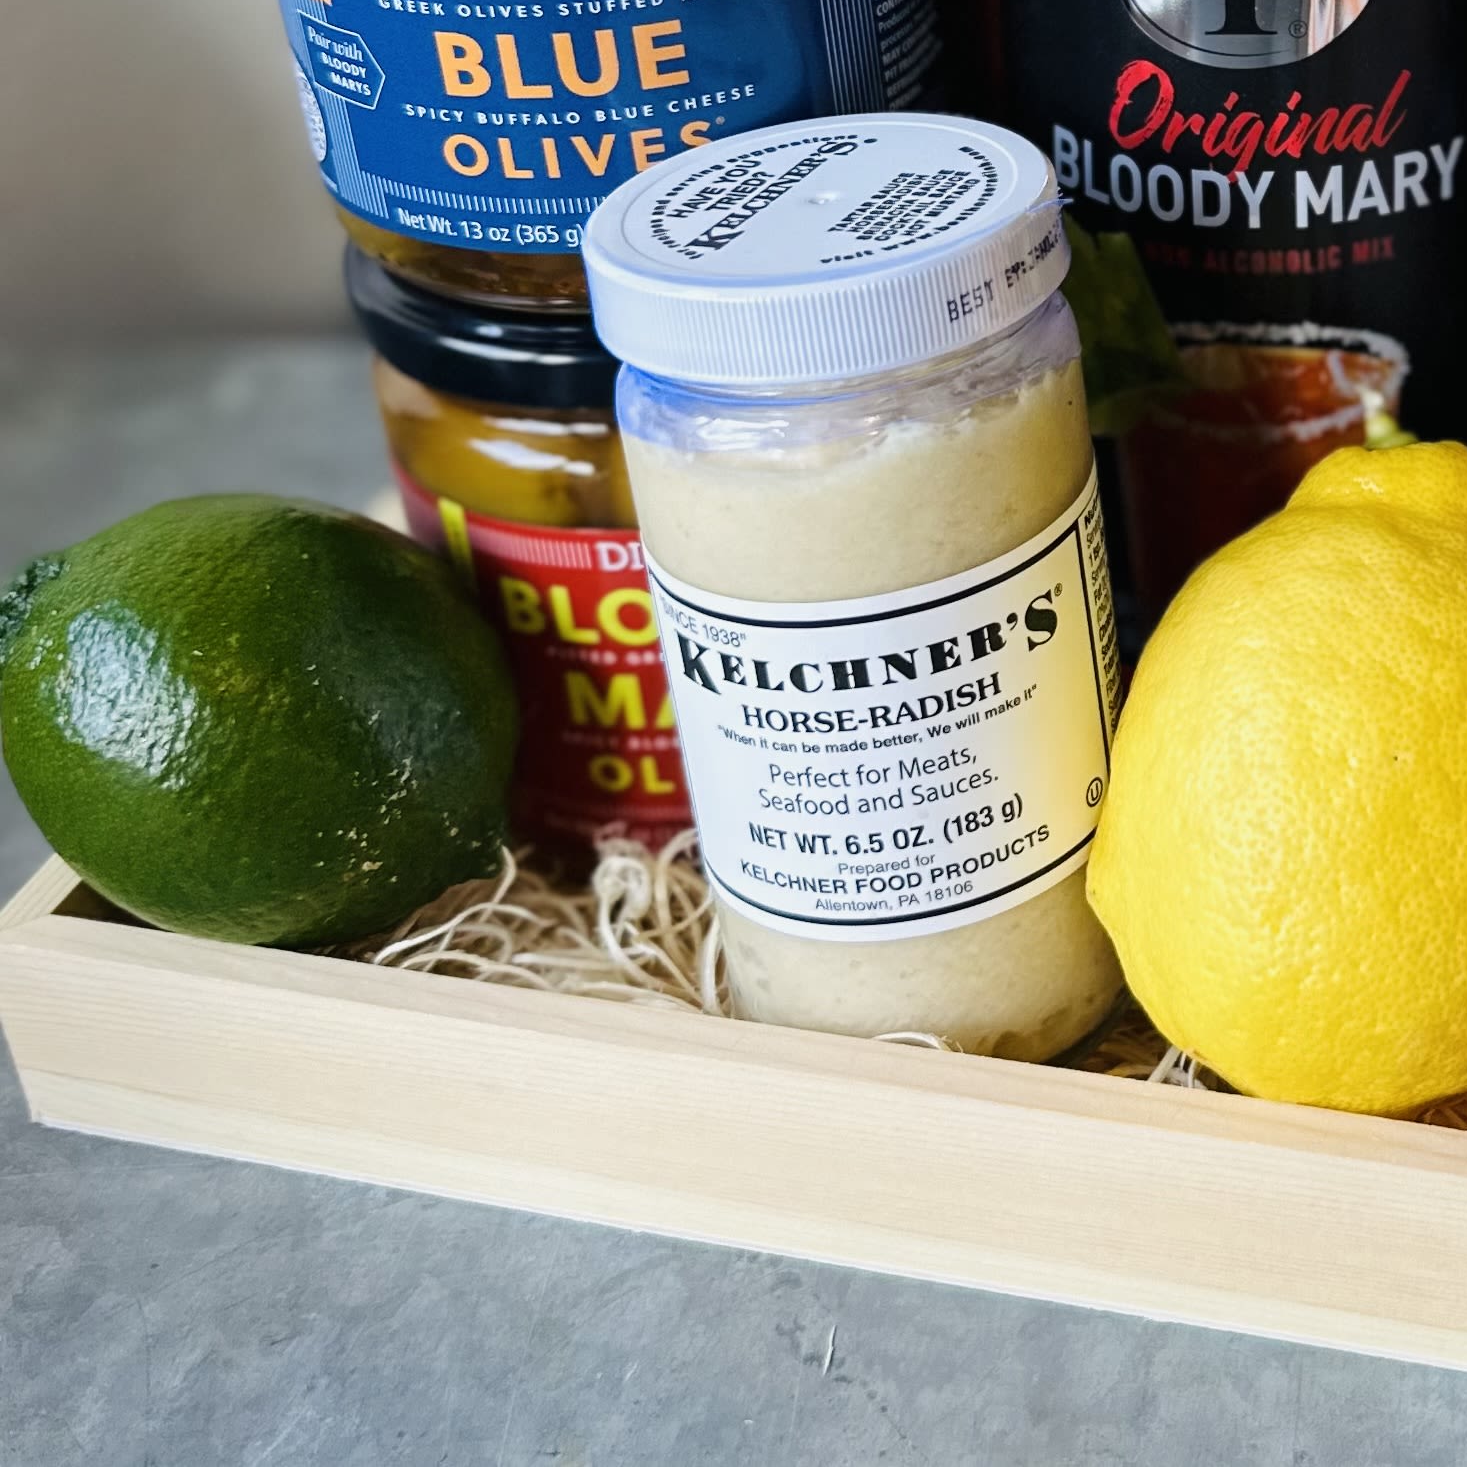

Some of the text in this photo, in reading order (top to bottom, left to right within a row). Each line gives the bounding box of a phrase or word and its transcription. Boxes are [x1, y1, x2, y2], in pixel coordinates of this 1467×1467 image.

[458, 2, 544, 20] OLIVES
[308, 25, 364, 63] Pair with
[321, 51, 367, 79] BLOODY
[434, 20, 690, 100] BLUE
[329, 70, 372, 97] MARYS
[406, 84, 756, 127] SPICY BUFFALO BLUE CHEESE
[1108, 58, 1412, 184] Original
[666, 159, 762, 218] HAVE YOU
[704, 171, 776, 212] TRIED?
[1053, 123, 1466, 230] BLOODY MARY
[399, 208, 426, 232] Net
[428, 215, 457, 239] Wt.
[461, 220, 484, 241] 13
[488, 225, 511, 243] oz
[514, 222, 557, 248] (365
[1352, 236, 1395, 264] MIX
[741, 671, 1002, 734] HORSE-RADISH
[758, 735, 770, 751] it
[772, 740, 798, 754] can
[801, 741, 821, 754] be
[824, 738, 869, 754] made
[872, 731, 924, 751] better,
[927, 722, 951, 738] We
[954, 710, 980, 733] will
[984, 697, 1021, 723] make
[768, 747, 978, 789] Perfect for Meats,
[758, 767, 1000, 816] Seafood and Sauces.
[748, 792, 1024, 856] NET WT. 6.5 OZ. (183 g)
[739, 823, 1051, 895] KELCHNER FOOD PRODUCTS
[837, 852, 937, 879] Prepared for
[814, 880, 974, 913] Allentown, PA 18106
